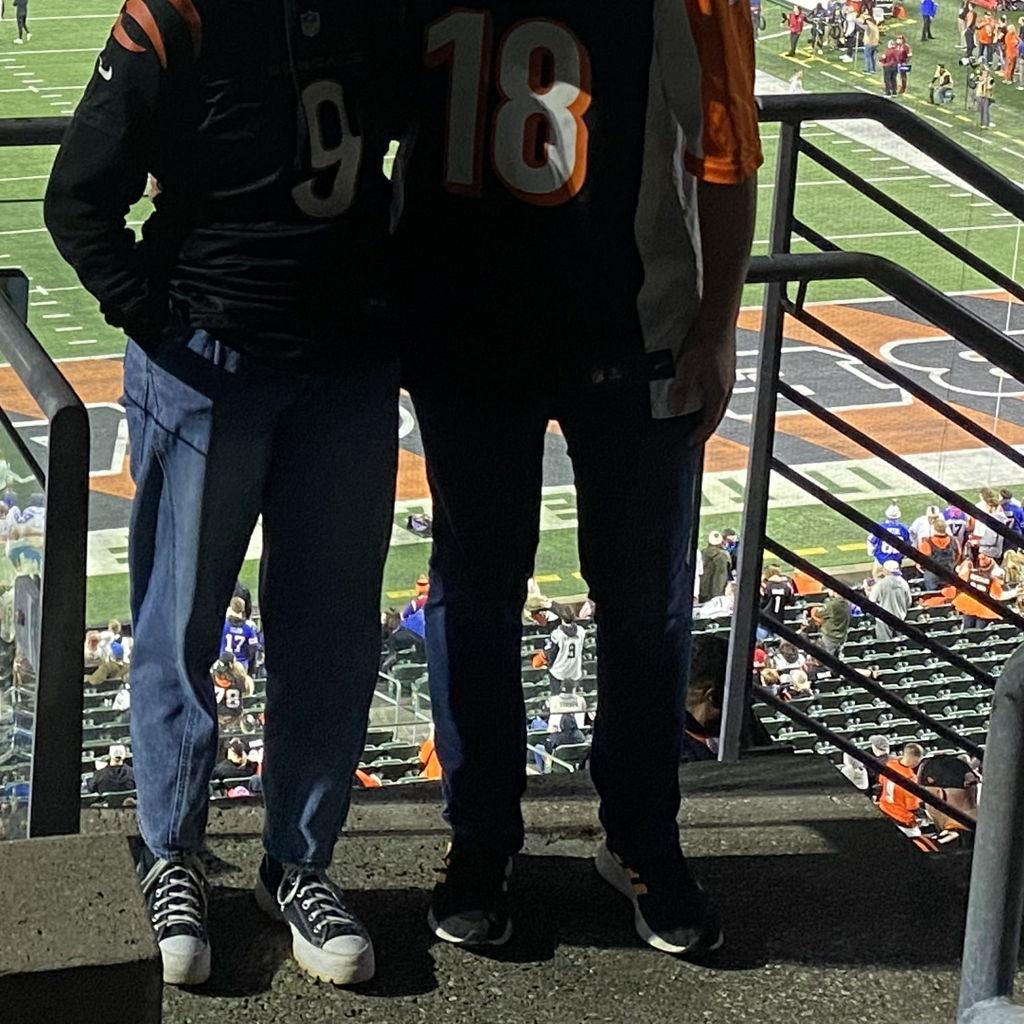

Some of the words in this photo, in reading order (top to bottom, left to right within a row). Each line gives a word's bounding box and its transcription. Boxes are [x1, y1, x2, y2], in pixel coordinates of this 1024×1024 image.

[291, 79, 364, 219] 9
[422, 6, 594, 208] 18
[224, 633, 246, 654] 17
